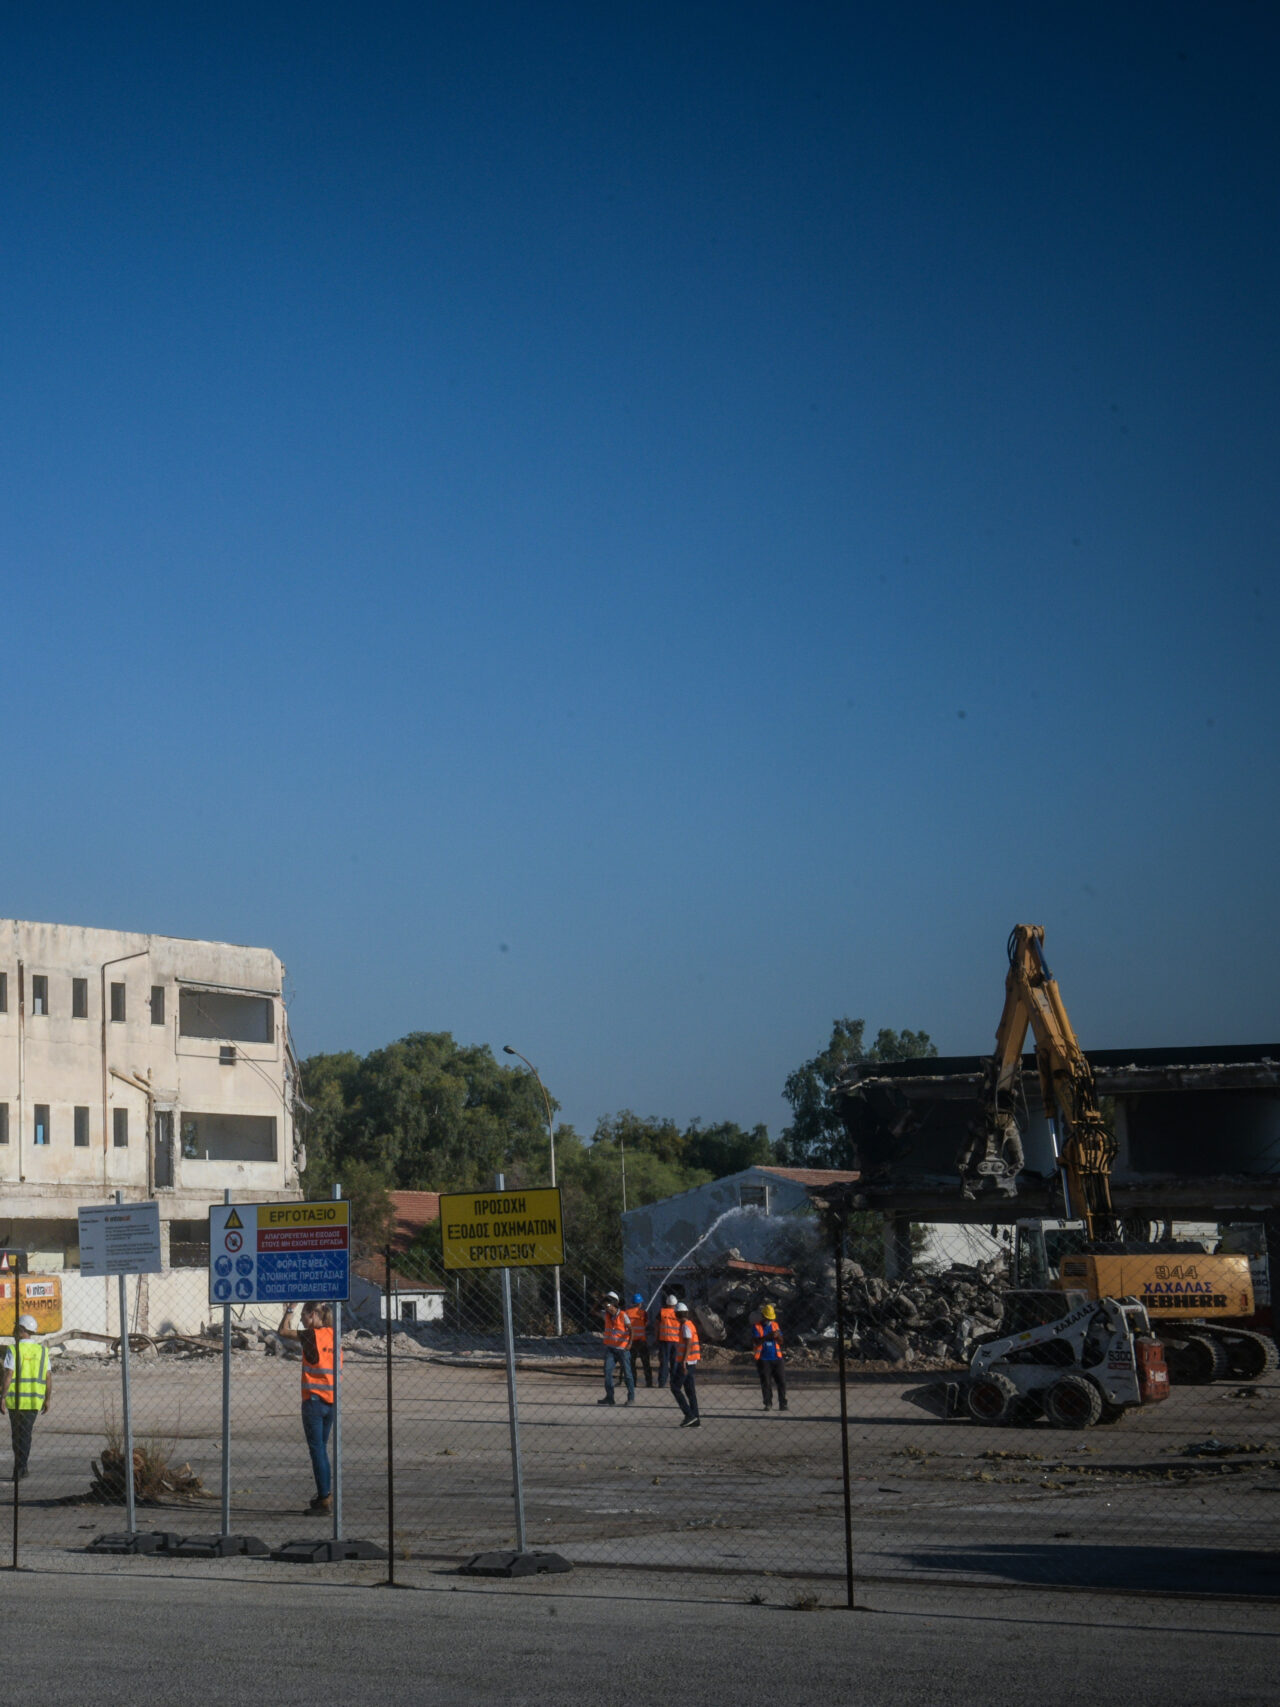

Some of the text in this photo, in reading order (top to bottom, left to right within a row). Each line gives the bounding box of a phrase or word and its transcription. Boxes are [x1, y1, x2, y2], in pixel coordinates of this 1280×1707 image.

[474, 1198, 527, 1216] ΠΡΟΣΟΧΗ
[269, 1208, 336, 1223] ΕΡΓΟΤΑΞΙΟ
[264, 1232, 309, 1240] ΑΠΑΓΟΡΕΥΕΤΑΙ
[315, 1230, 340, 1238] ΕΙΣΟΔΟΣ
[448, 1219, 557, 1240] ΕΞΟΔΟΣ ΟΧΗΜΑΤΩΝ
[261, 1240, 280, 1248] ΣΤΟΥΣ
[291, 1239, 319, 1247] ΕΧΟΝΤΕΣ
[319, 1238, 343, 1246] ΕΡΓΑΣΙΑ
[469, 1243, 536, 1261] ΕΡΓΟΤΑΞΙΟΥ
[276, 1259, 308, 1269] ΦΟΡΑΤΕ
[260, 1270, 344, 1281] ΑΤΟΜΙΚΗΣ ΠΡΟΣΤΑΣΙΑΣ
[1154, 1265, 1199, 1280] 944
[287, 1282, 339, 1293] ΠΡΟΒΛΕΠΕΤΑΙ
[1143, 1281, 1213, 1294] ΧΑΧΑΛΑΣ
[1138, 1294, 1228, 1308] IEBHERR
[1053, 1303, 1096, 1334] ΧΑΧΑΛΑΣ
